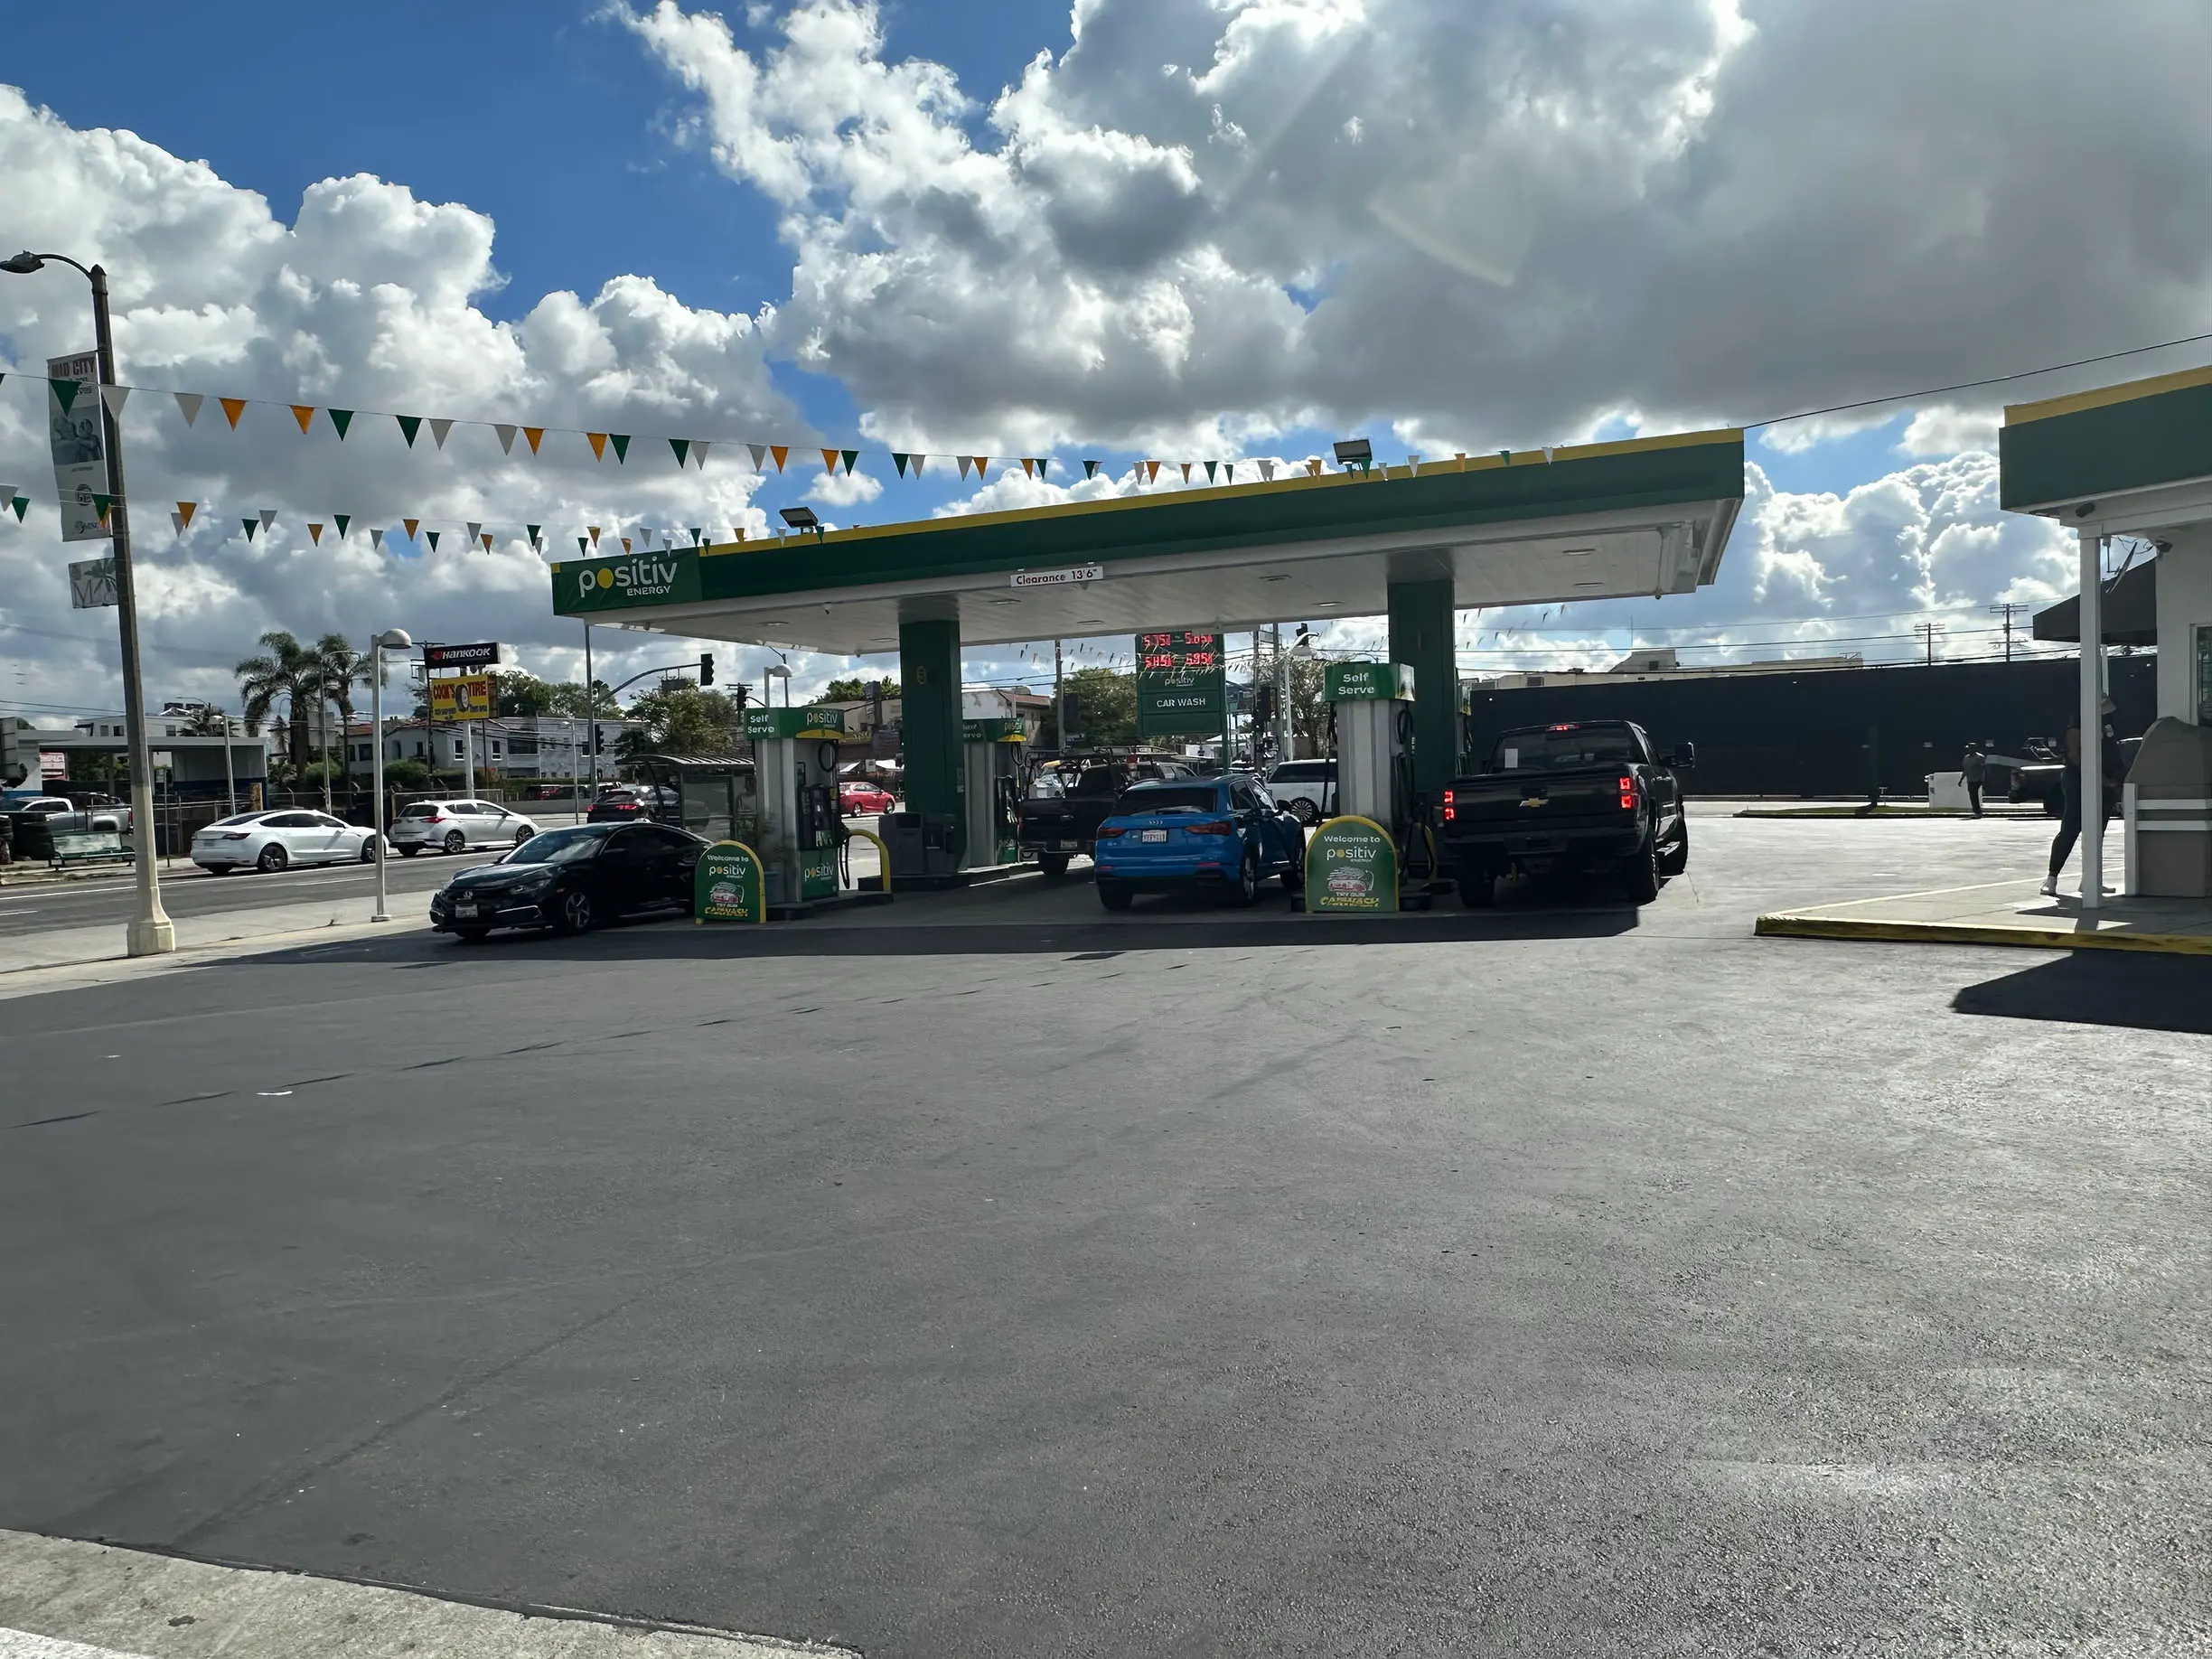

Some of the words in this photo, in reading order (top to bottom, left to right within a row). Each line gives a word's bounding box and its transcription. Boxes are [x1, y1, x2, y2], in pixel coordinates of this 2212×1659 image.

[73, 356, 95, 375] CITY
[578, 556, 678, 598] positiv
[1017, 574, 1065, 586] Clearance
[626, 586, 671, 596] ENERGY
[1343, 672, 1369, 682] Self
[467, 681, 487, 697] TIRE
[1338, 686, 1374, 695] Serve
[1157, 699, 1175, 708] CAR
[1177, 698, 1205, 707] WASH
[750, 714, 769, 723] Self
[747, 726, 774, 734] Serve
[1326, 846, 1376, 860] positiv
[708, 864, 746, 876] positiv
